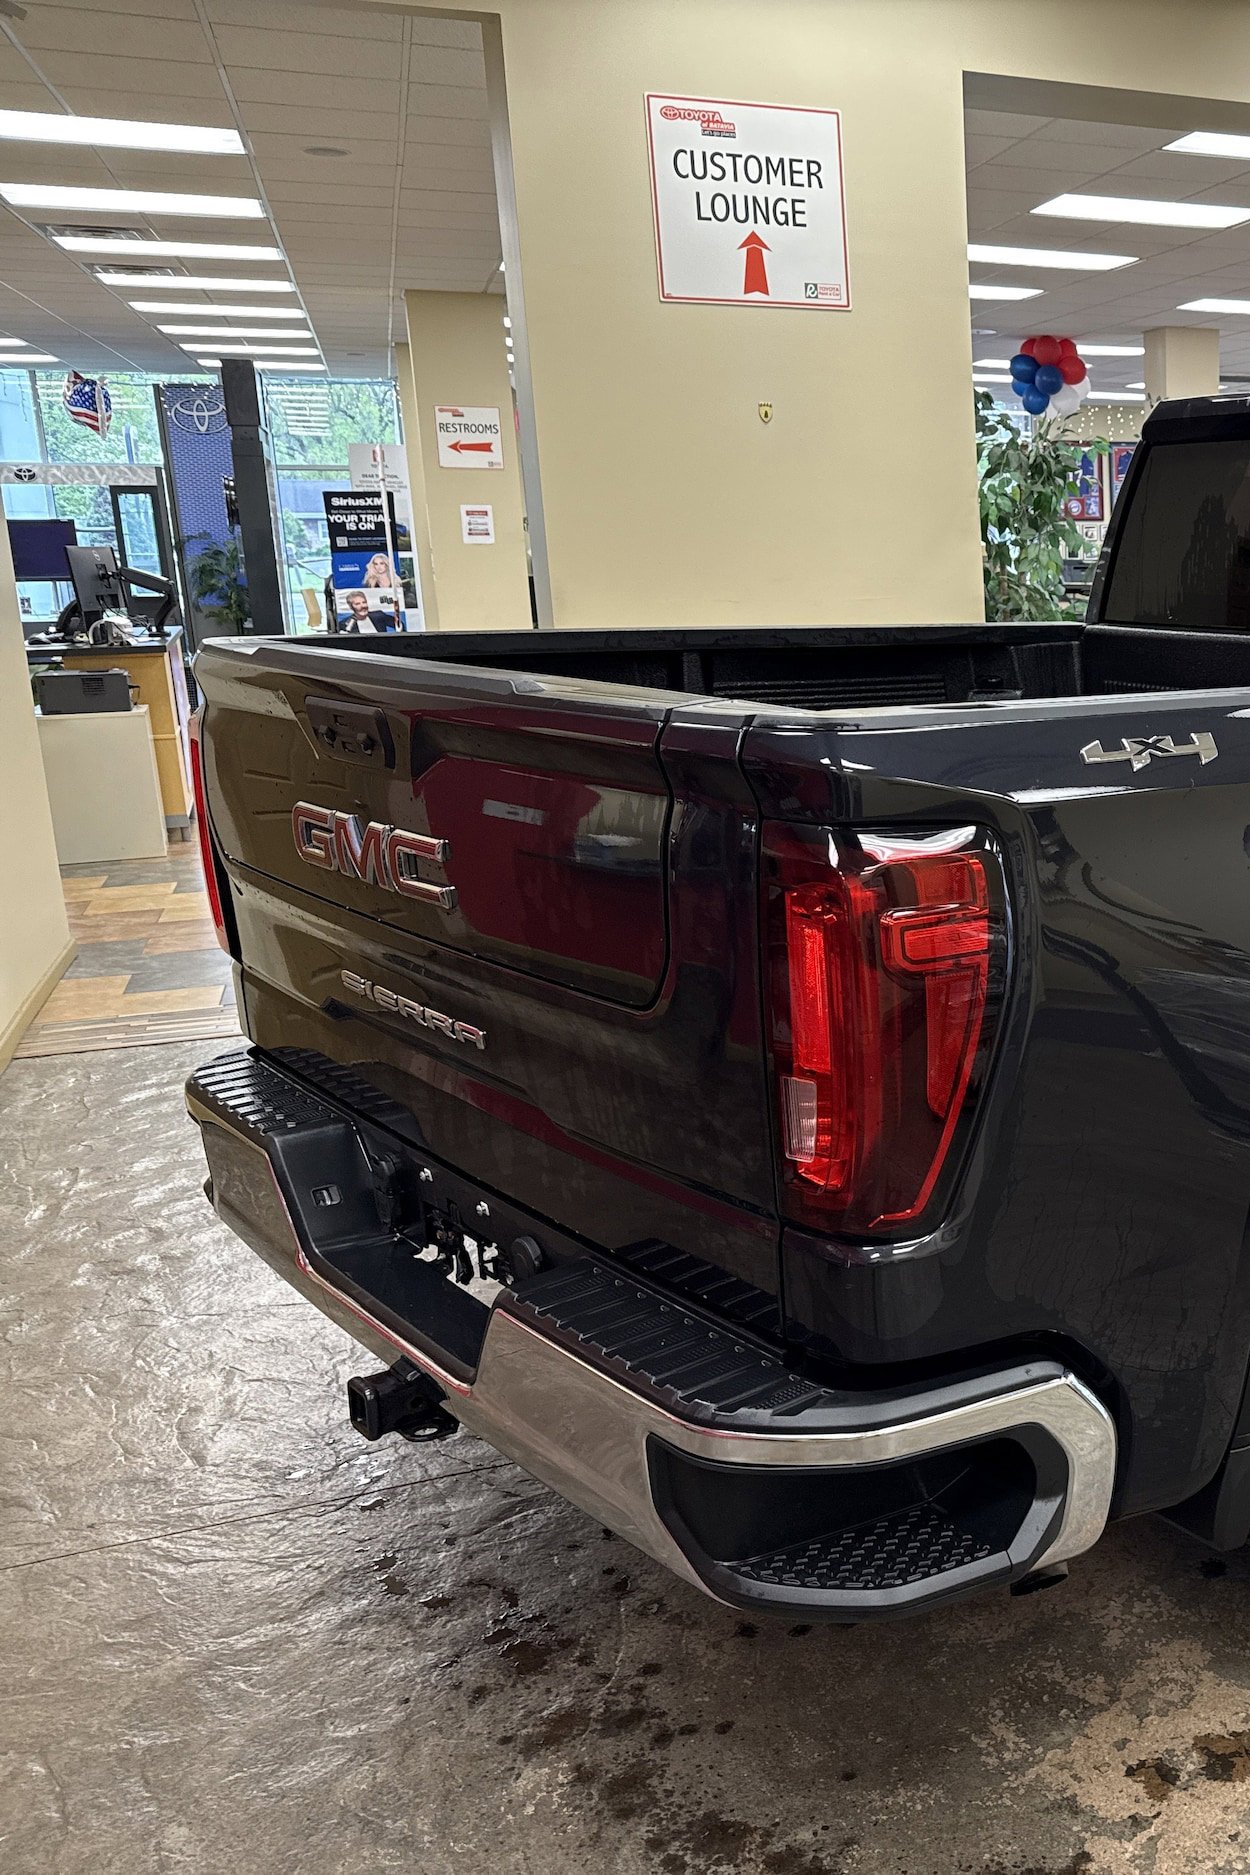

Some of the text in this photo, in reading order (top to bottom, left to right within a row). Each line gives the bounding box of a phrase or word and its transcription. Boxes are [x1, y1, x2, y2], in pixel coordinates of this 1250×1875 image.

[678, 109, 722, 122] TOYOTA
[673, 148, 823, 189] CUSTOMER
[695, 191, 807, 227] LOUNGE
[438, 422, 499, 435] RESTROOMS
[327, 514, 358, 523] YOUR
[345, 522, 375, 531] IS ON
[291, 800, 459, 909] GMC
[340, 969, 487, 1050] SIERRA
